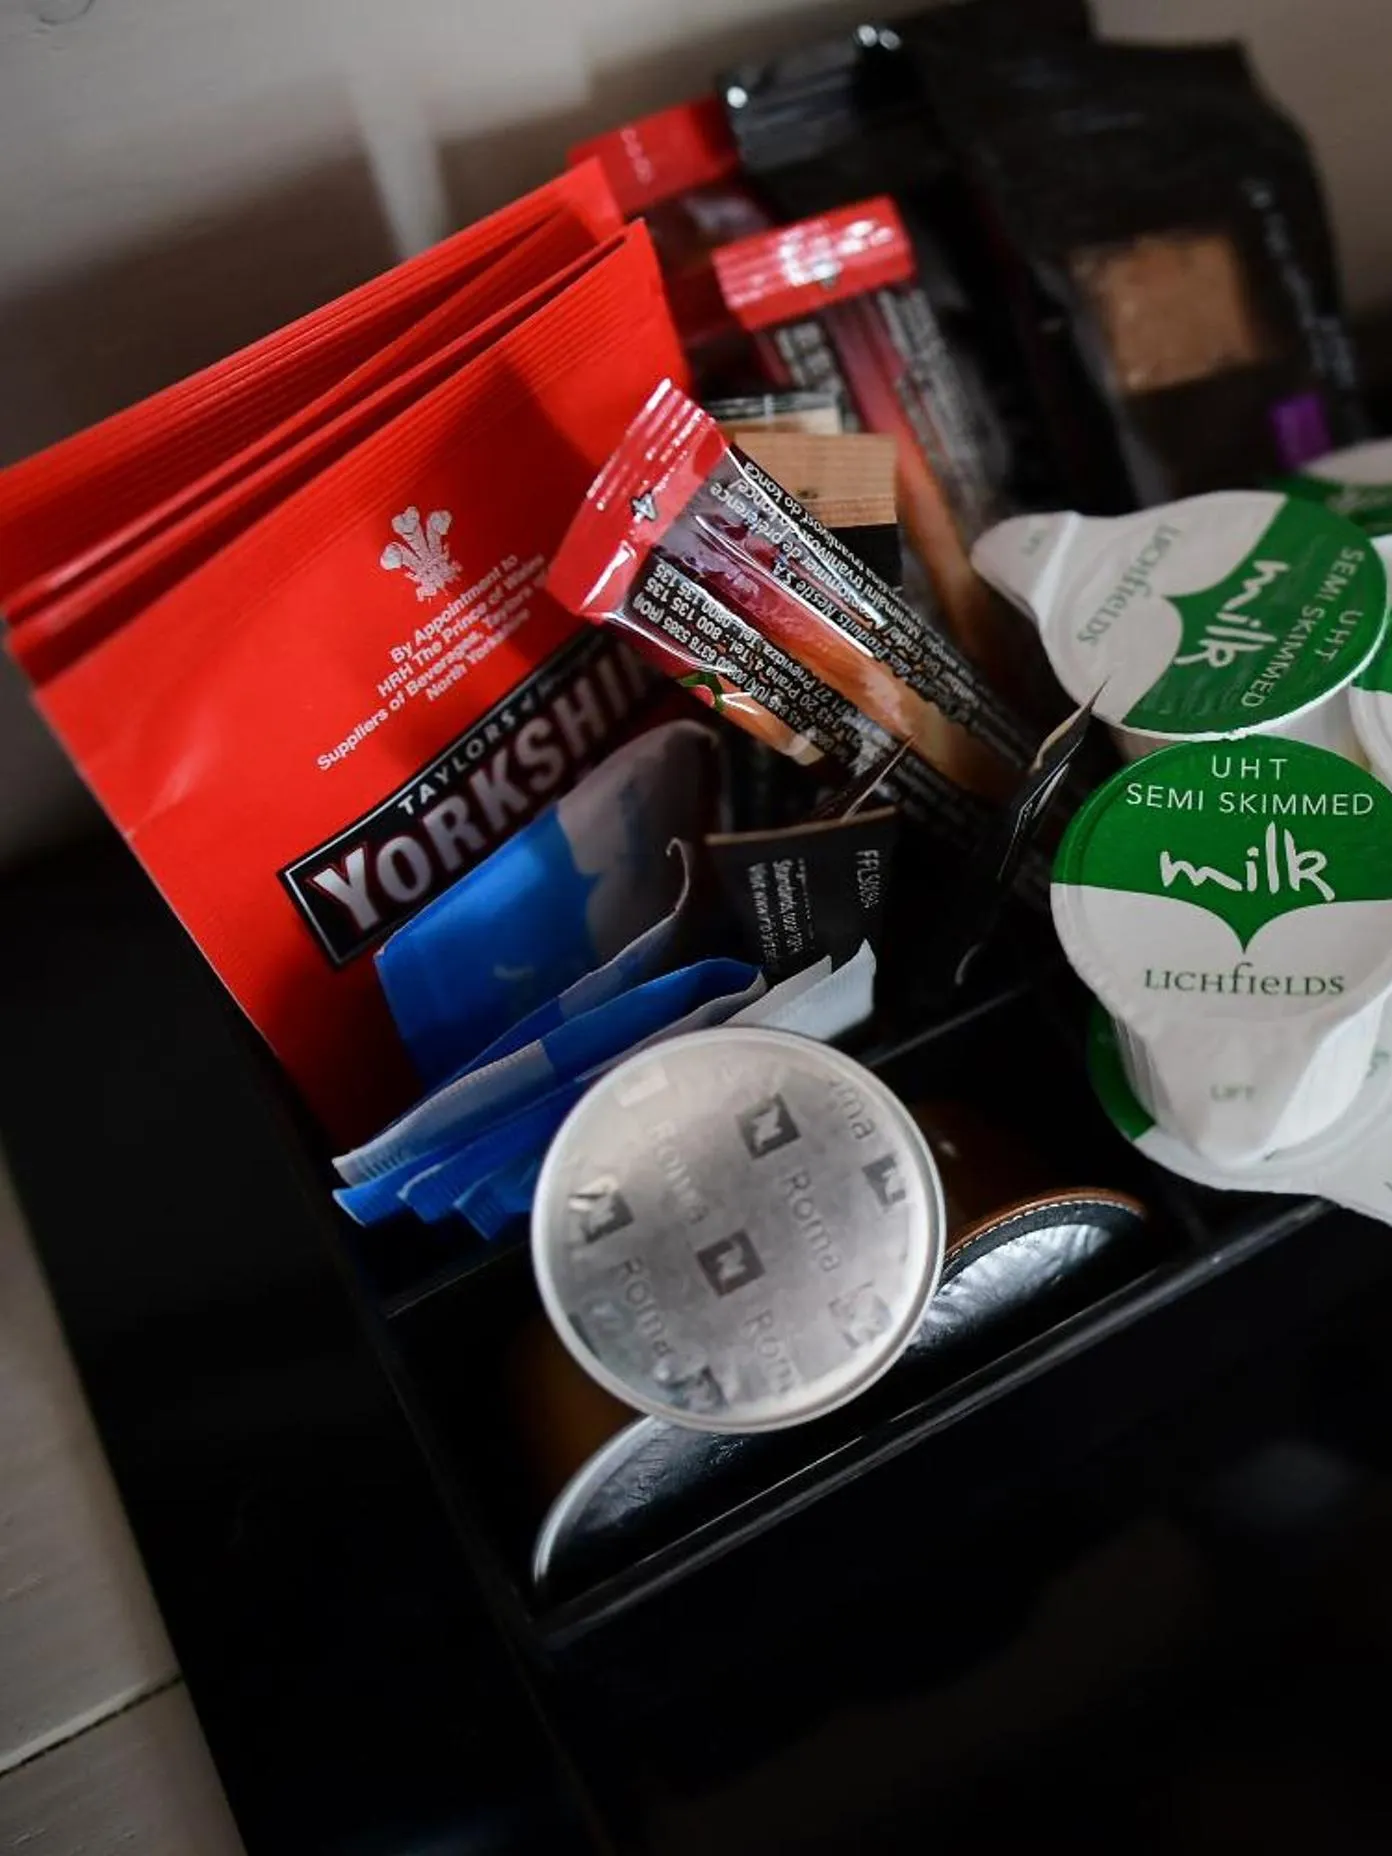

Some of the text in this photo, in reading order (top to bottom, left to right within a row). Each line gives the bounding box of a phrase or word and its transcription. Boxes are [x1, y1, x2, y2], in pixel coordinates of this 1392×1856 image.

[741, 462, 784, 501] konca
[781, 496, 802, 516] do
[780, 541, 801, 560] de
[643, 577, 672, 602] 135
[652, 563, 679, 587] 135
[389, 554, 518, 664] By Appointment to
[669, 596, 697, 621] 135
[676, 582, 702, 605] 135
[695, 615, 723, 640] 800
[700, 600, 732, 628] 0800
[1173, 560, 1289, 668] milk
[1242, 546, 1365, 707] SEMI SKIMMED
[377, 662, 413, 697] HRH
[412, 641, 442, 667] The
[442, 602, 487, 643] Prince
[687, 636, 717, 662] 6378
[835, 614, 888, 658] Produits
[1316, 611, 1363, 662] UHT
[425, 663, 468, 700] North
[763, 666, 800, 698] Praha
[798, 693, 818, 711] 20
[317, 707, 388, 771] Suppliers
[389, 691, 406, 711] of
[399, 711, 517, 816] TAYLORS
[1211, 755, 1288, 780] UHT
[1126, 783, 1374, 816] SEMI SKIMMED
[1160, 820, 1335, 902] milk
[1210, 1083, 1256, 1101] LIFT
[781, 1169, 841, 1275] Roma
[614, 1258, 675, 1361] Roma
